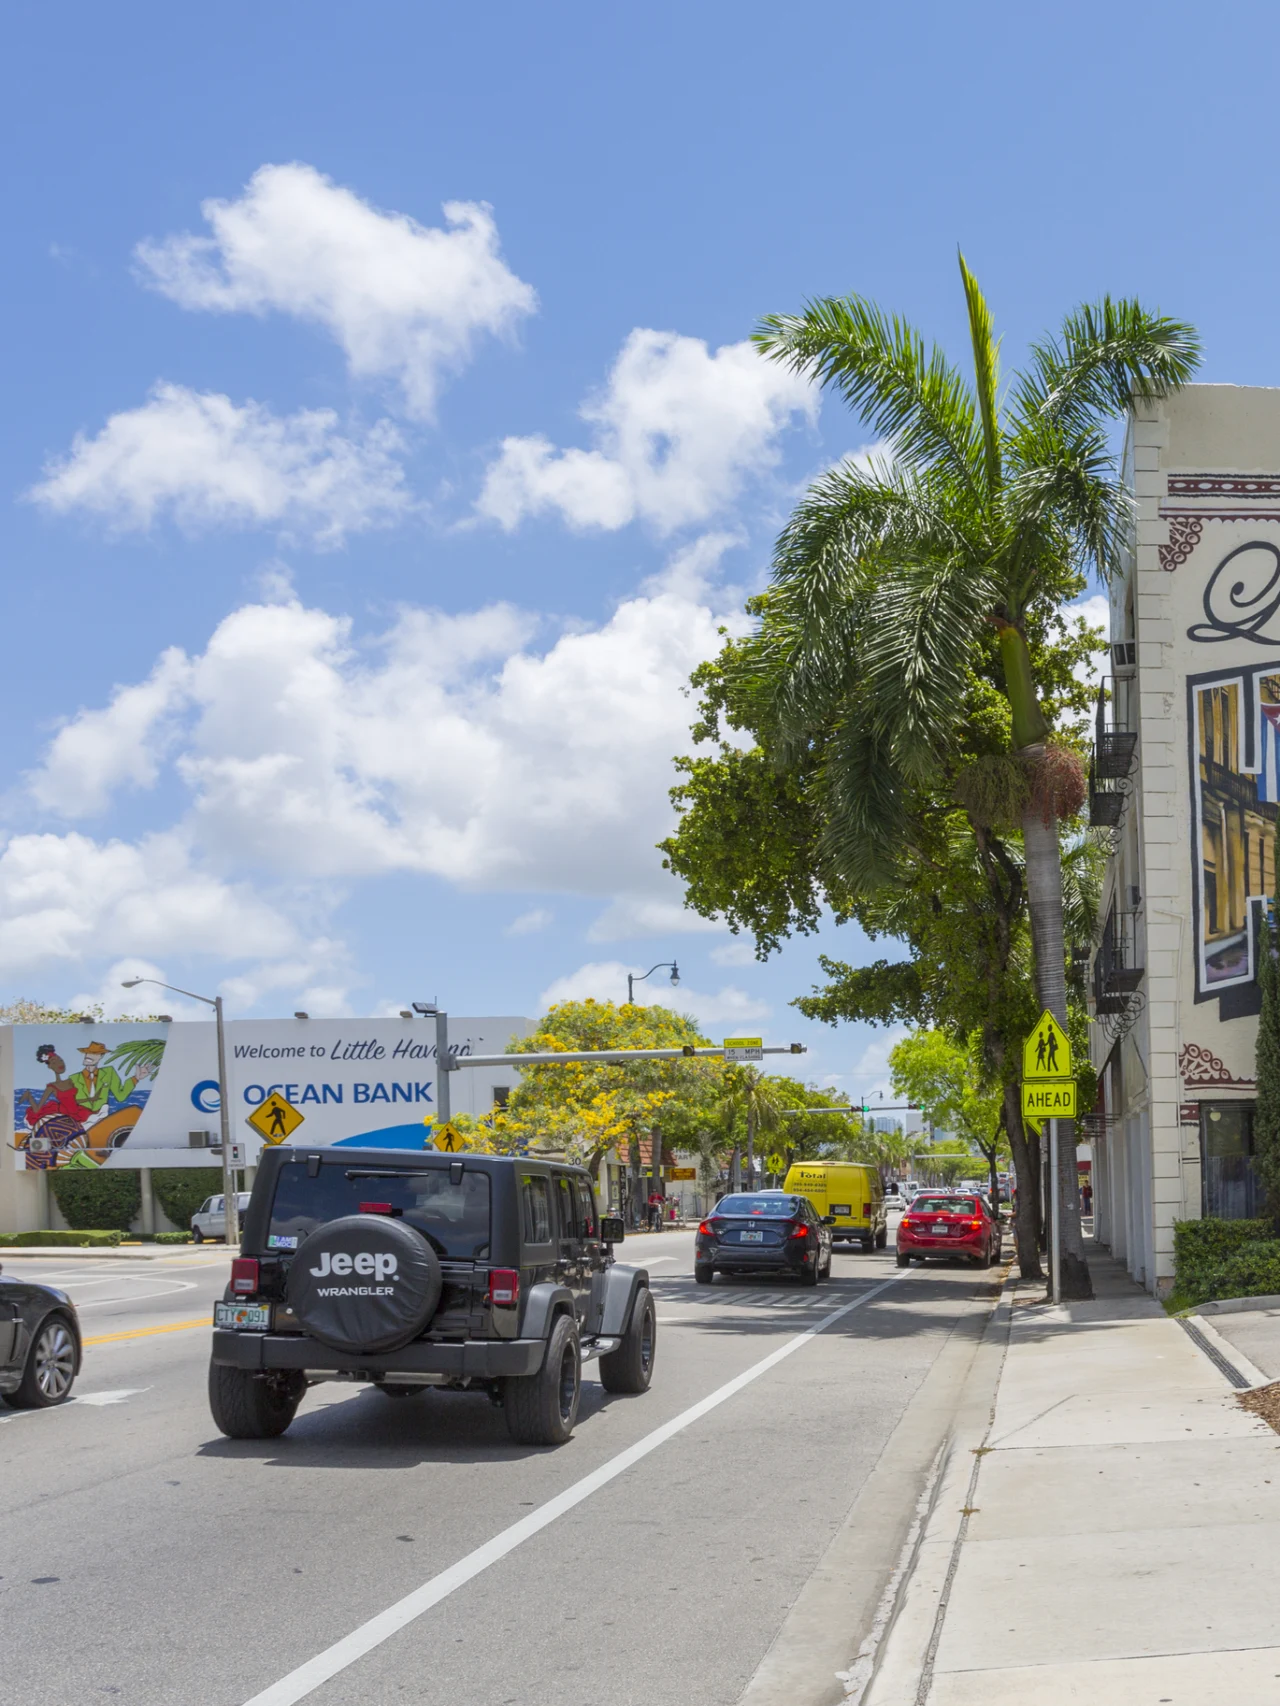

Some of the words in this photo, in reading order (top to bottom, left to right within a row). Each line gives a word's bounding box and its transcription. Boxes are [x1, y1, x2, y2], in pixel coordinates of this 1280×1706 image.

[234, 1044, 306, 1058] Welcome
[309, 1045, 326, 1058] to
[330, 1038, 386, 1061] Little
[392, 1038, 473, 1060] Havna
[243, 1083, 344, 1106] OCEAN
[353, 1081, 434, 1104] BANK
[1027, 1091, 1072, 1108] AHEAD
[569, 1157, 581, 1166] 30
[796, 1170, 827, 1179] Total
[309, 1252, 398, 1282] Jeep
[317, 1286, 395, 1298] WRANGLER
